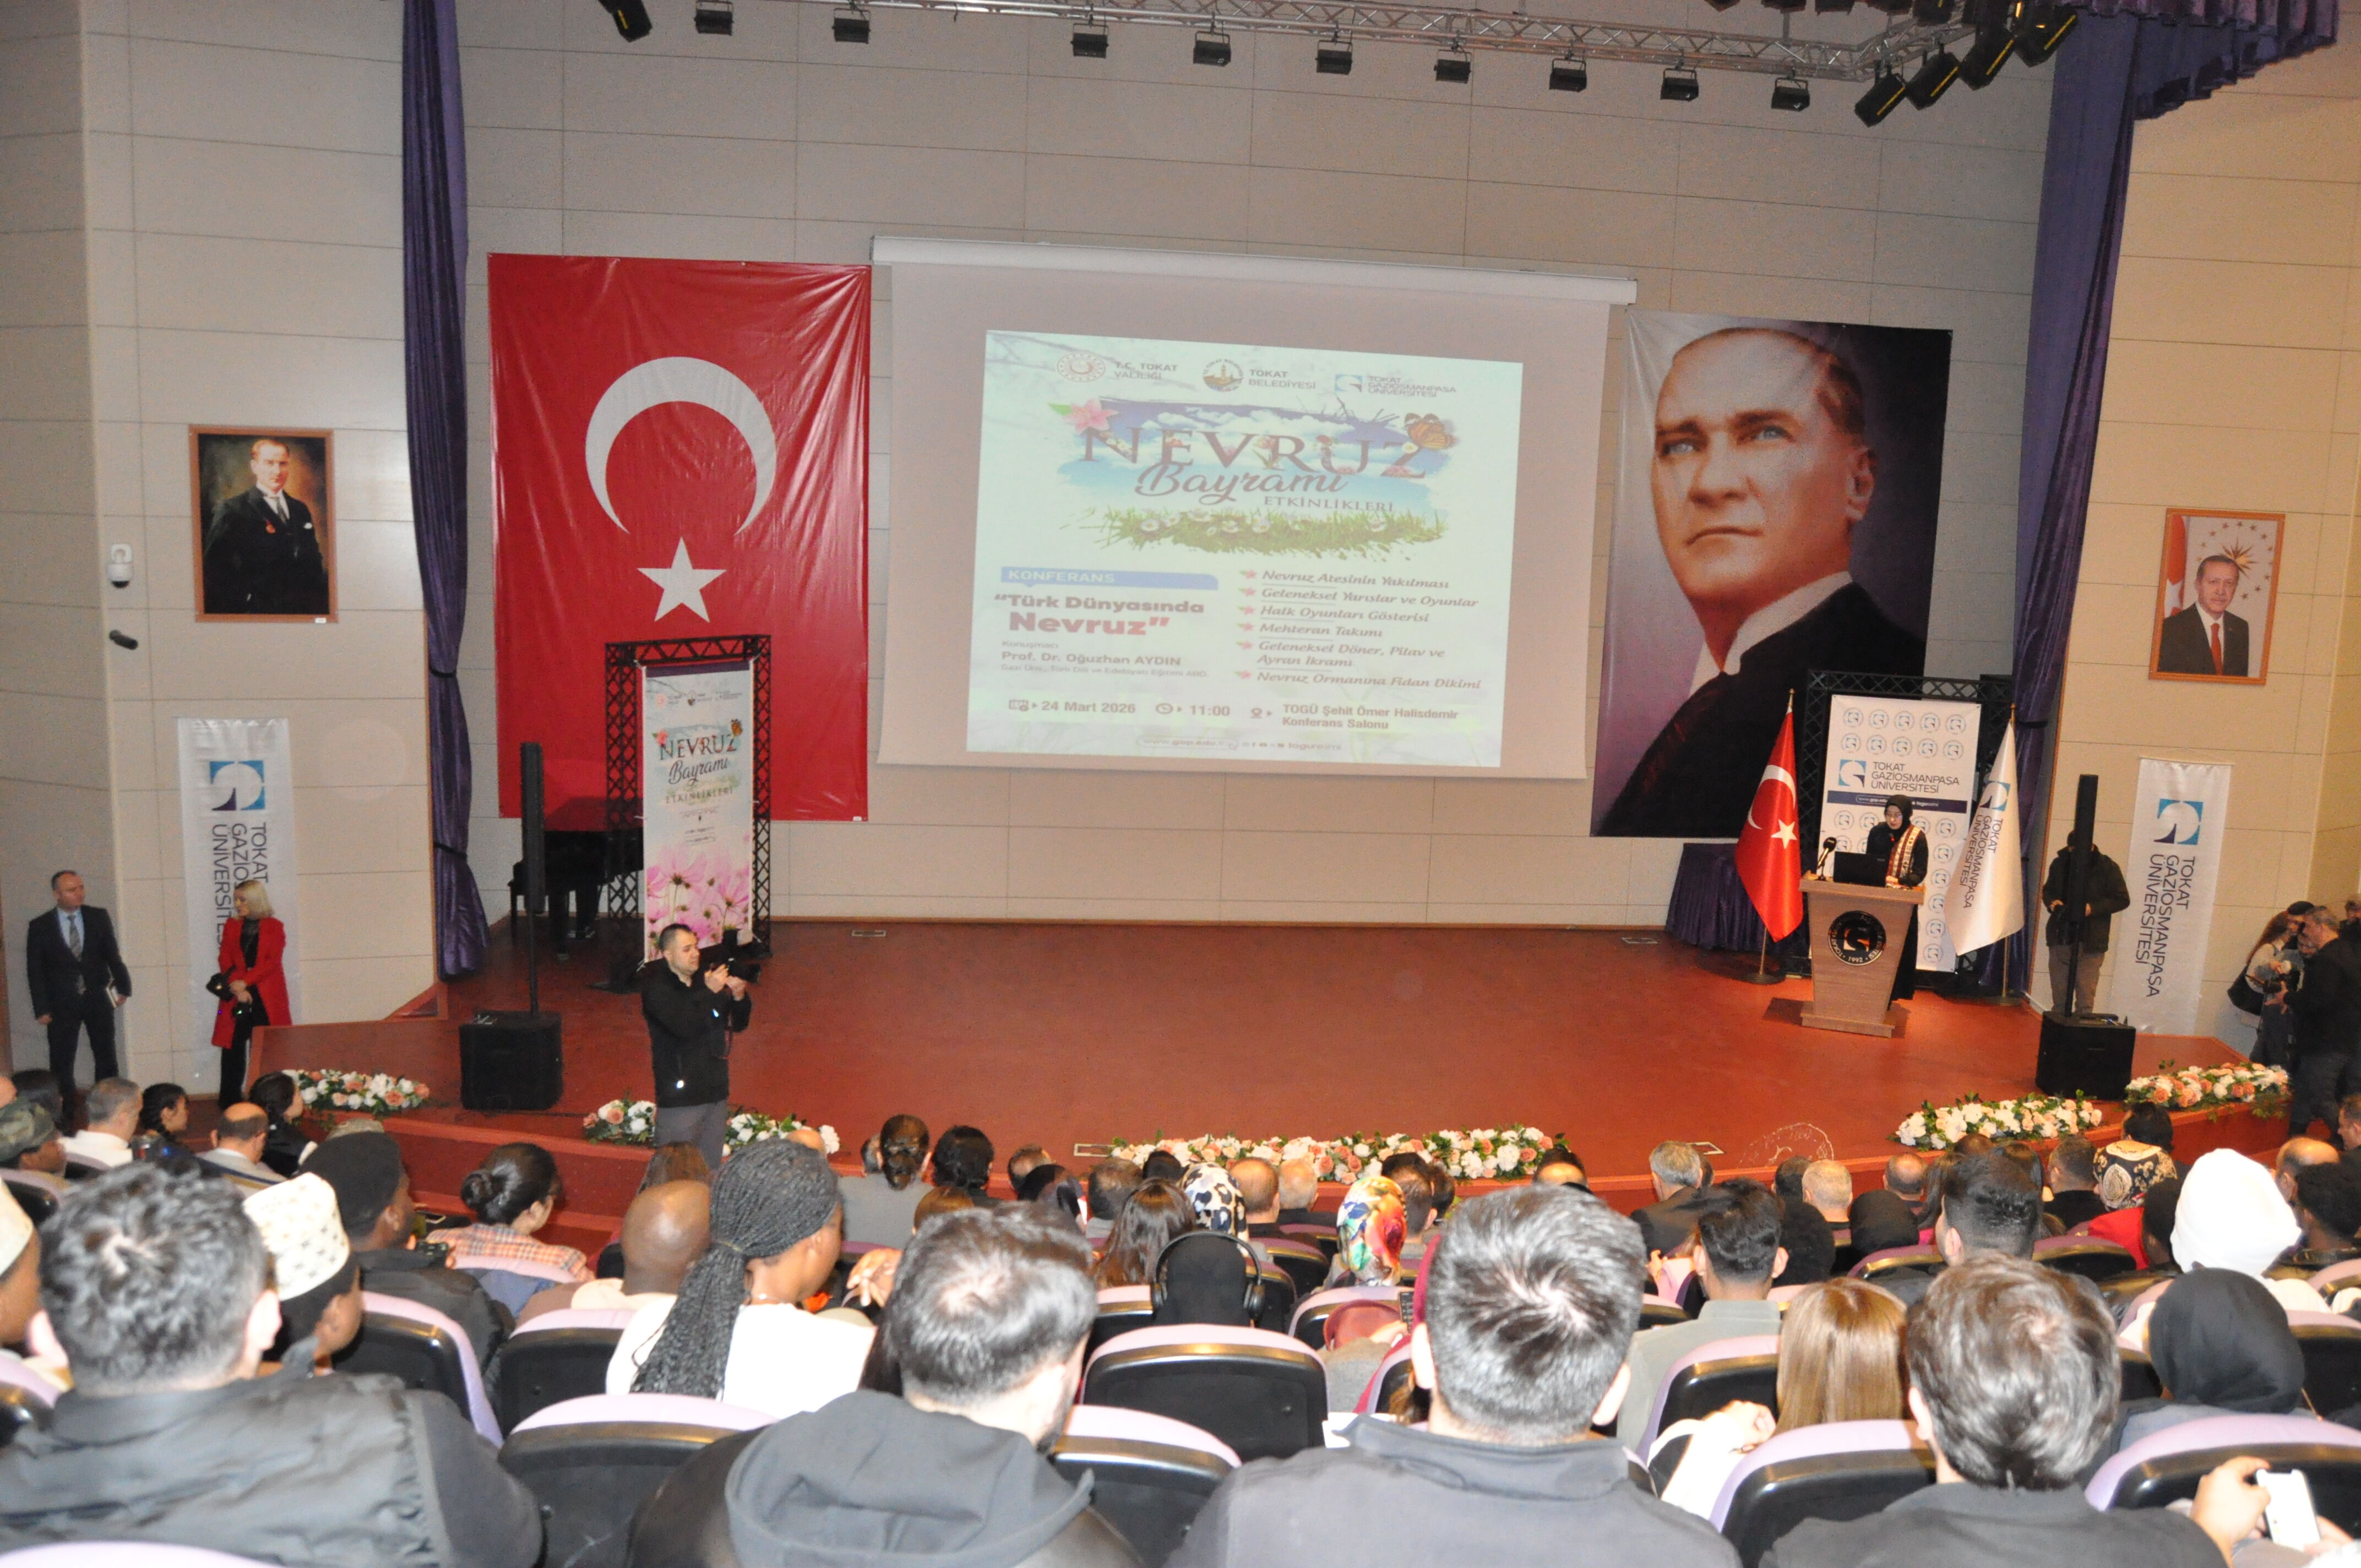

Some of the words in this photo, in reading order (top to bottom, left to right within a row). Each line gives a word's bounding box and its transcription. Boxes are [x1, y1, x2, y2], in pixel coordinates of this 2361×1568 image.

[1140, 363, 1178, 372] TOKAT
[1249, 369, 1288, 378] TOKAT
[1249, 378, 1316, 389] BELEDİYESİ
[1079, 427, 1426, 479] NEVRUZ
[1134, 461, 1349, 505] Bayramı
[1264, 496, 1394, 512] ETKİNLİKLERİ
[1008, 570, 1116, 584] KONFERANS
[1263, 570, 1314, 583] Nevruz
[1382, 576, 1449, 589] Yakılması
[1065, 597, 1204, 613] Dünyasında
[1261, 588, 1337, 600] Geleneksel
[1421, 596, 1479, 607] Oyunlar
[1260, 606, 1295, 616] Halk
[1300, 607, 1363, 619] Oyunları
[1368, 611, 1430, 622] Gösterisi
[1260, 623, 1330, 635] Mehteran
[1336, 626, 1382, 638] Takımı
[1259, 641, 1334, 652] Geleneksel
[1338, 644, 1384, 656] Döner,
[1390, 646, 1426, 656] Pilav
[1429, 650, 1445, 658] ve
[1002, 651, 1036, 661] Prof.
[1041, 653, 1060, 662] Dr.
[1066, 654, 1130, 665] Oğuzhan
[1134, 656, 1180, 665] AYDIN
[1257, 655, 1301, 666] Ayran
[1257, 672, 1309, 684] Nevruz
[1390, 677, 1430, 687] Fidan
[1434, 678, 1481, 689] Dikimi
[1042, 701, 1058, 711] 24
[1065, 701, 1097, 712] Mart
[1101, 703, 1136, 714] 2026
[1190, 705, 1231, 716] 11:00
[1283, 704, 1318, 714] TOGÜ
[1323, 705, 1354, 716] Şehit
[1357, 705, 1390, 716] Ömer
[1394, 708, 1459, 720] Halisdemir
[1282, 717, 1342, 728] Konferans
[1347, 719, 1389, 729] Salonu
[660, 734, 737, 760] NEVRUZ
[668, 758, 728, 787] Bayramı
[1873, 761, 1906, 771] TOKAT
[1871, 780, 1939, 793] ÜNİVERSİTESİ
[1872, 771, 1960, 786] GAZİOSMANPAŞA
[1987, 819, 2004, 853] TOKAT
[251, 823, 269, 883] TOKAT
[2176, 856, 2196, 910] TOKAT
[2135, 853, 2164, 964] ÜNİVERSİTESİ
[2146, 854, 2180, 997] GAZİOSMANPAŞA
